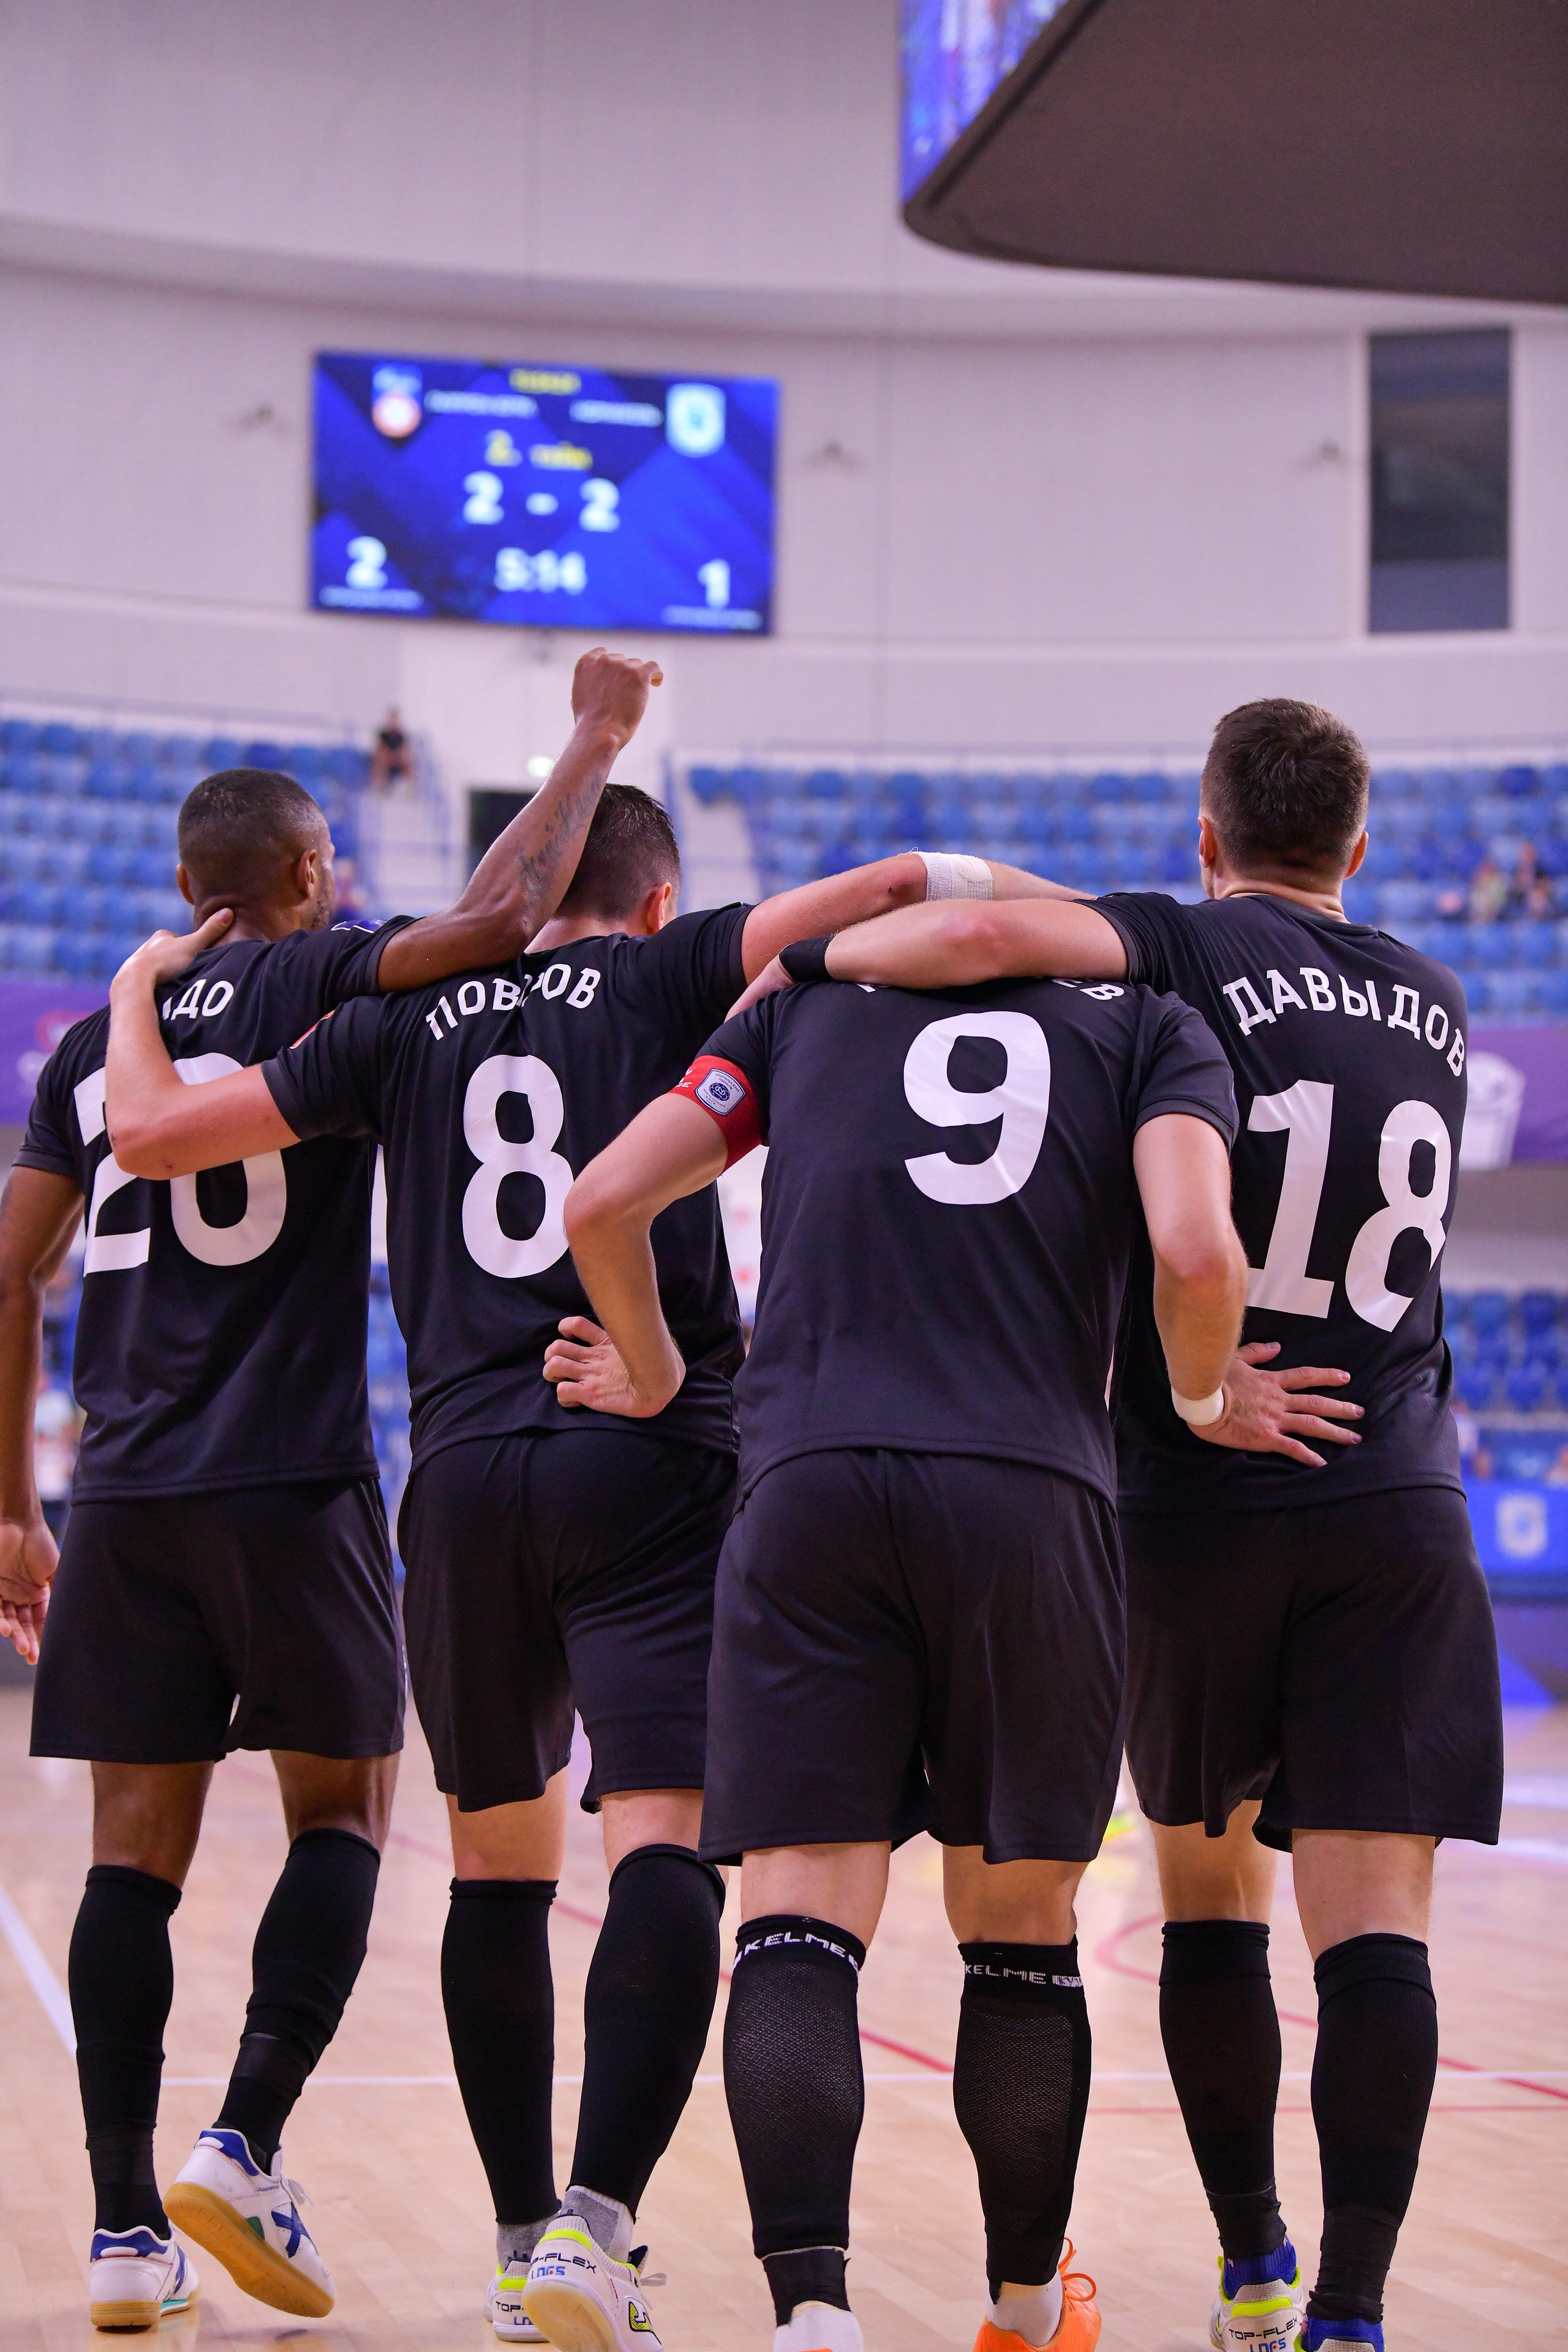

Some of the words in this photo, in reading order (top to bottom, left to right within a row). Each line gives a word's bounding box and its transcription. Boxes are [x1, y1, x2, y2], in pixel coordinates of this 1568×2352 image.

[463, 471, 504, 524] 2
[579, 478, 620, 532] 2
[346, 536, 388, 590] 2
[698, 559, 730, 608] 1
[1223, 967, 1466, 1076] ДАВЫДОВ
[904, 1011, 1050, 1204] 9
[462, 1055, 575, 1278] 8
[1246, 1079, 1452, 1333] 18
[744, 1931, 846, 1958] KELME
[965, 1964, 1046, 1985] KELME
[1229, 2315, 1298, 2340] TOP-FLEX
